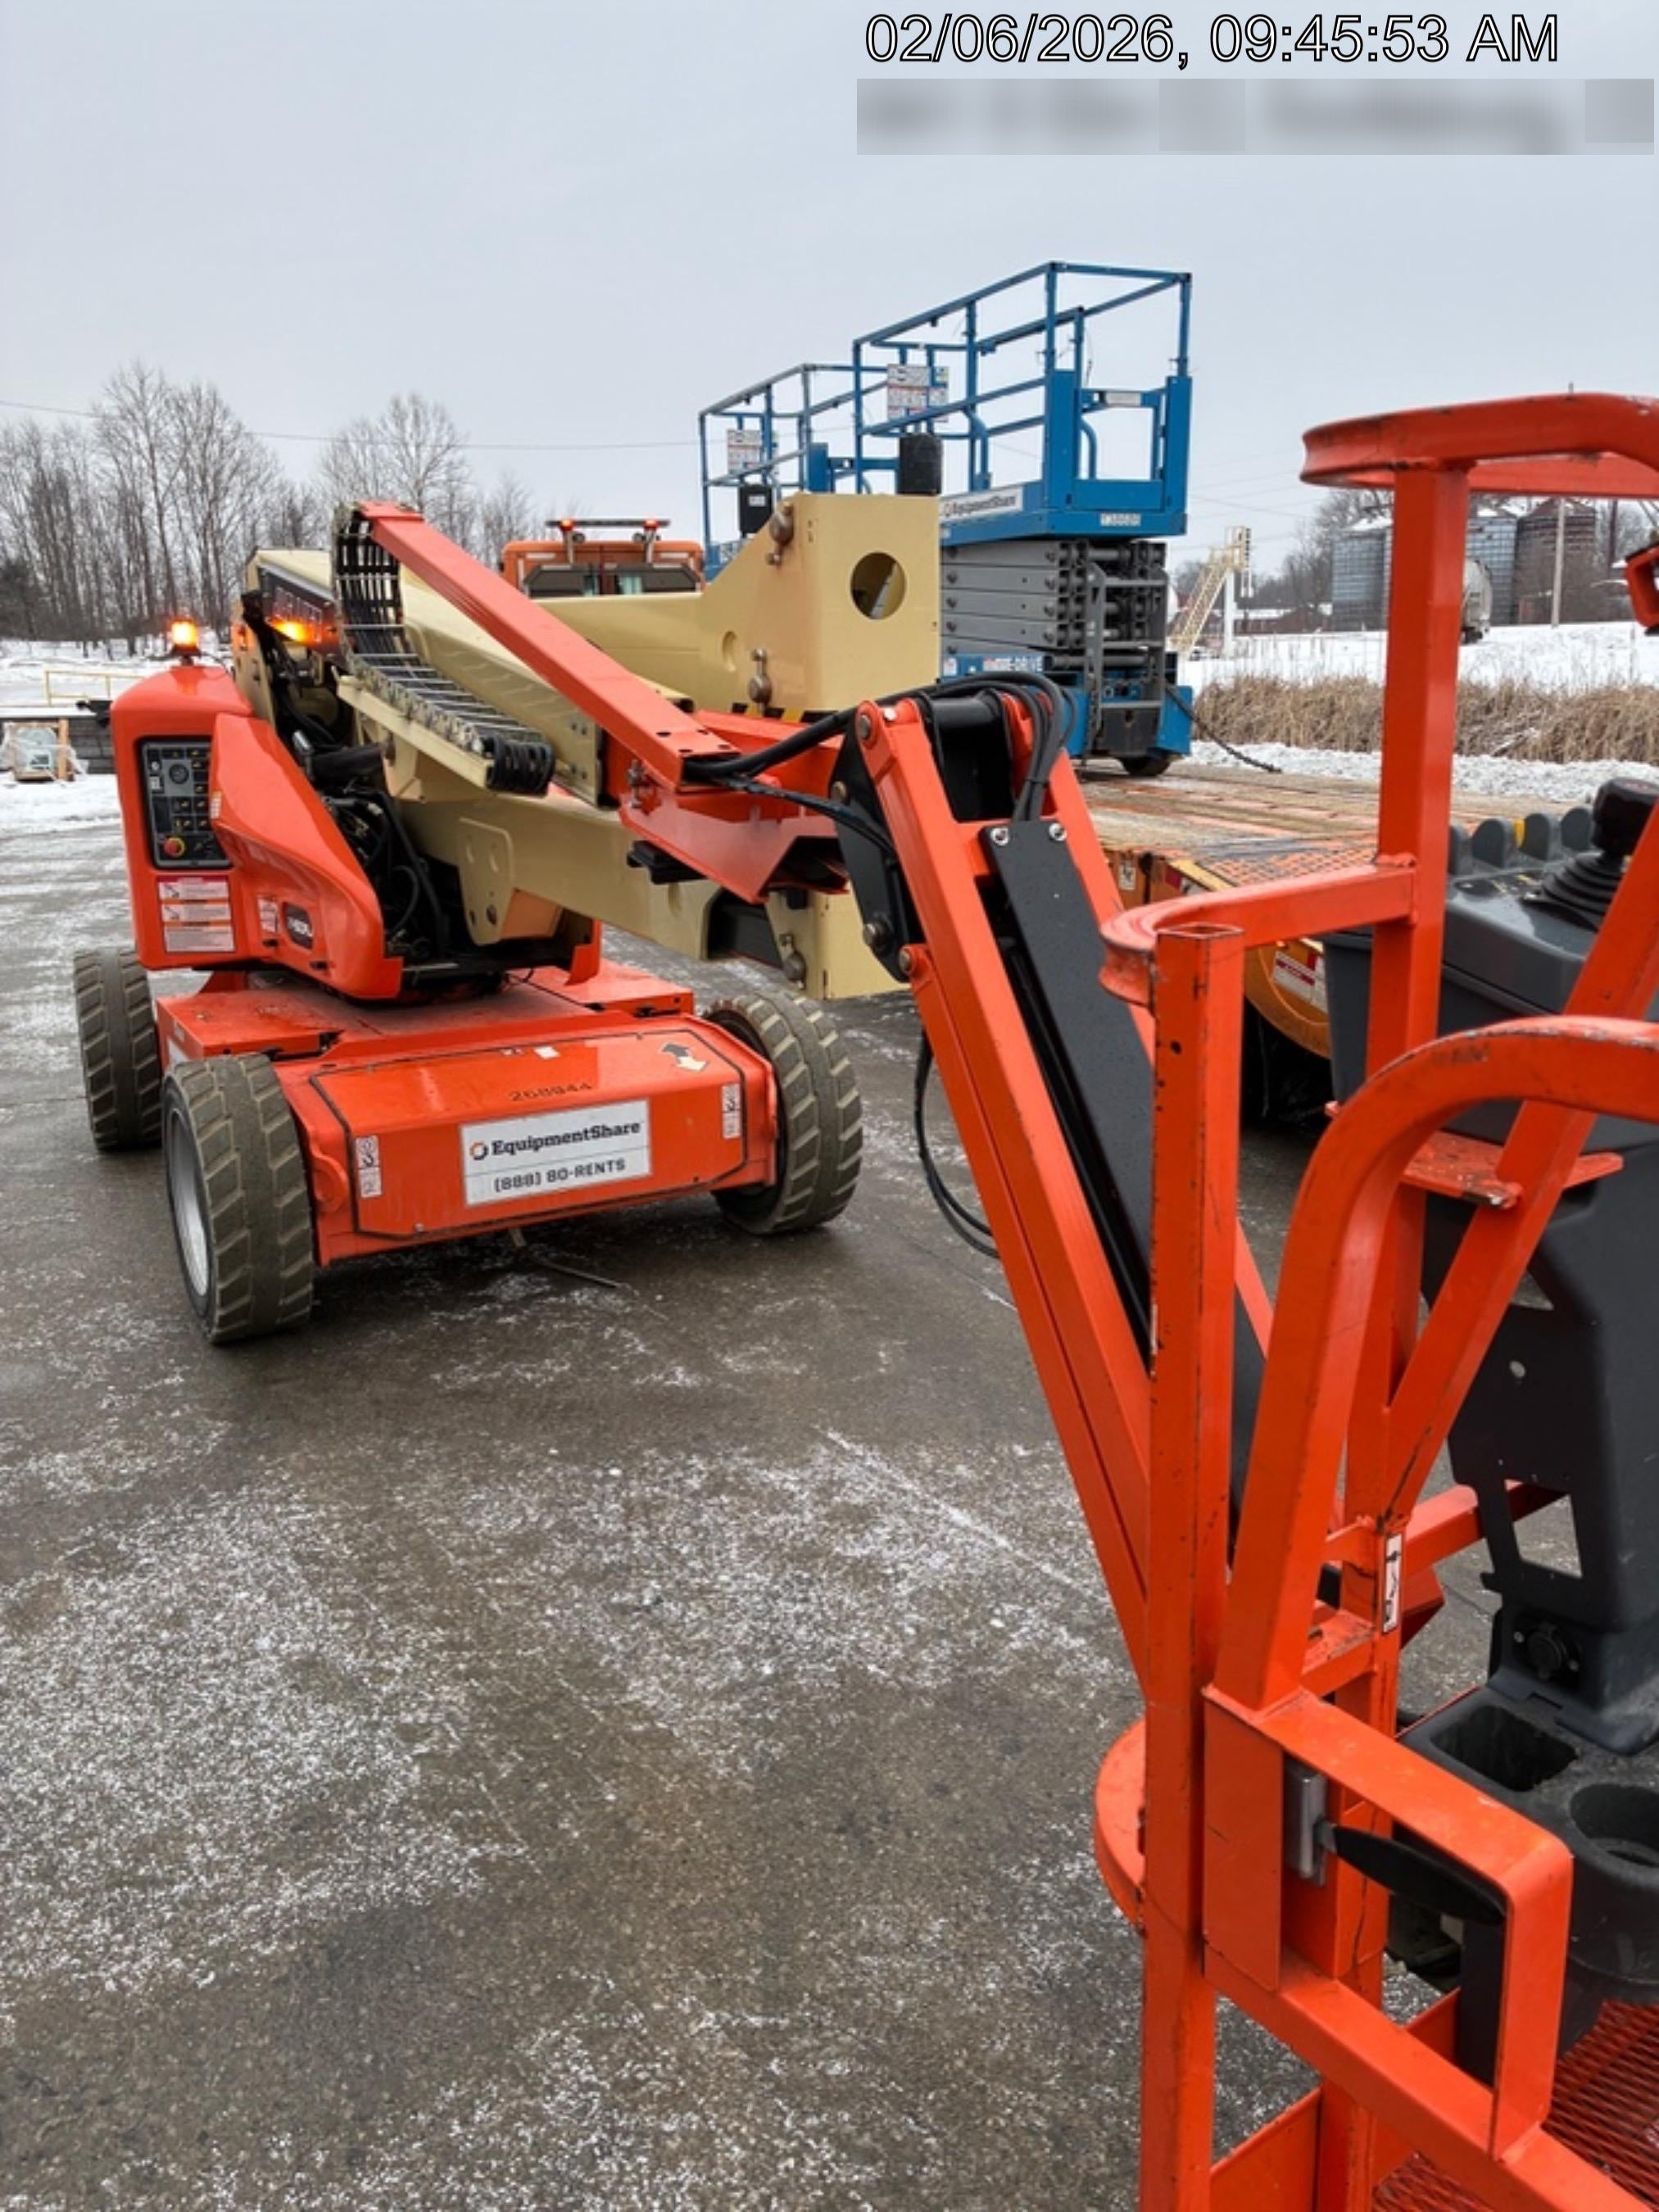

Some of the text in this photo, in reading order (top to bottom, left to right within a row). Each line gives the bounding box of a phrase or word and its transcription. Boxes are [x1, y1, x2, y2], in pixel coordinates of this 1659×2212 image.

[491, 1122, 641, 1156] EquipmentShare
[494, 1158, 626, 1193] (888) 80-RENTS
